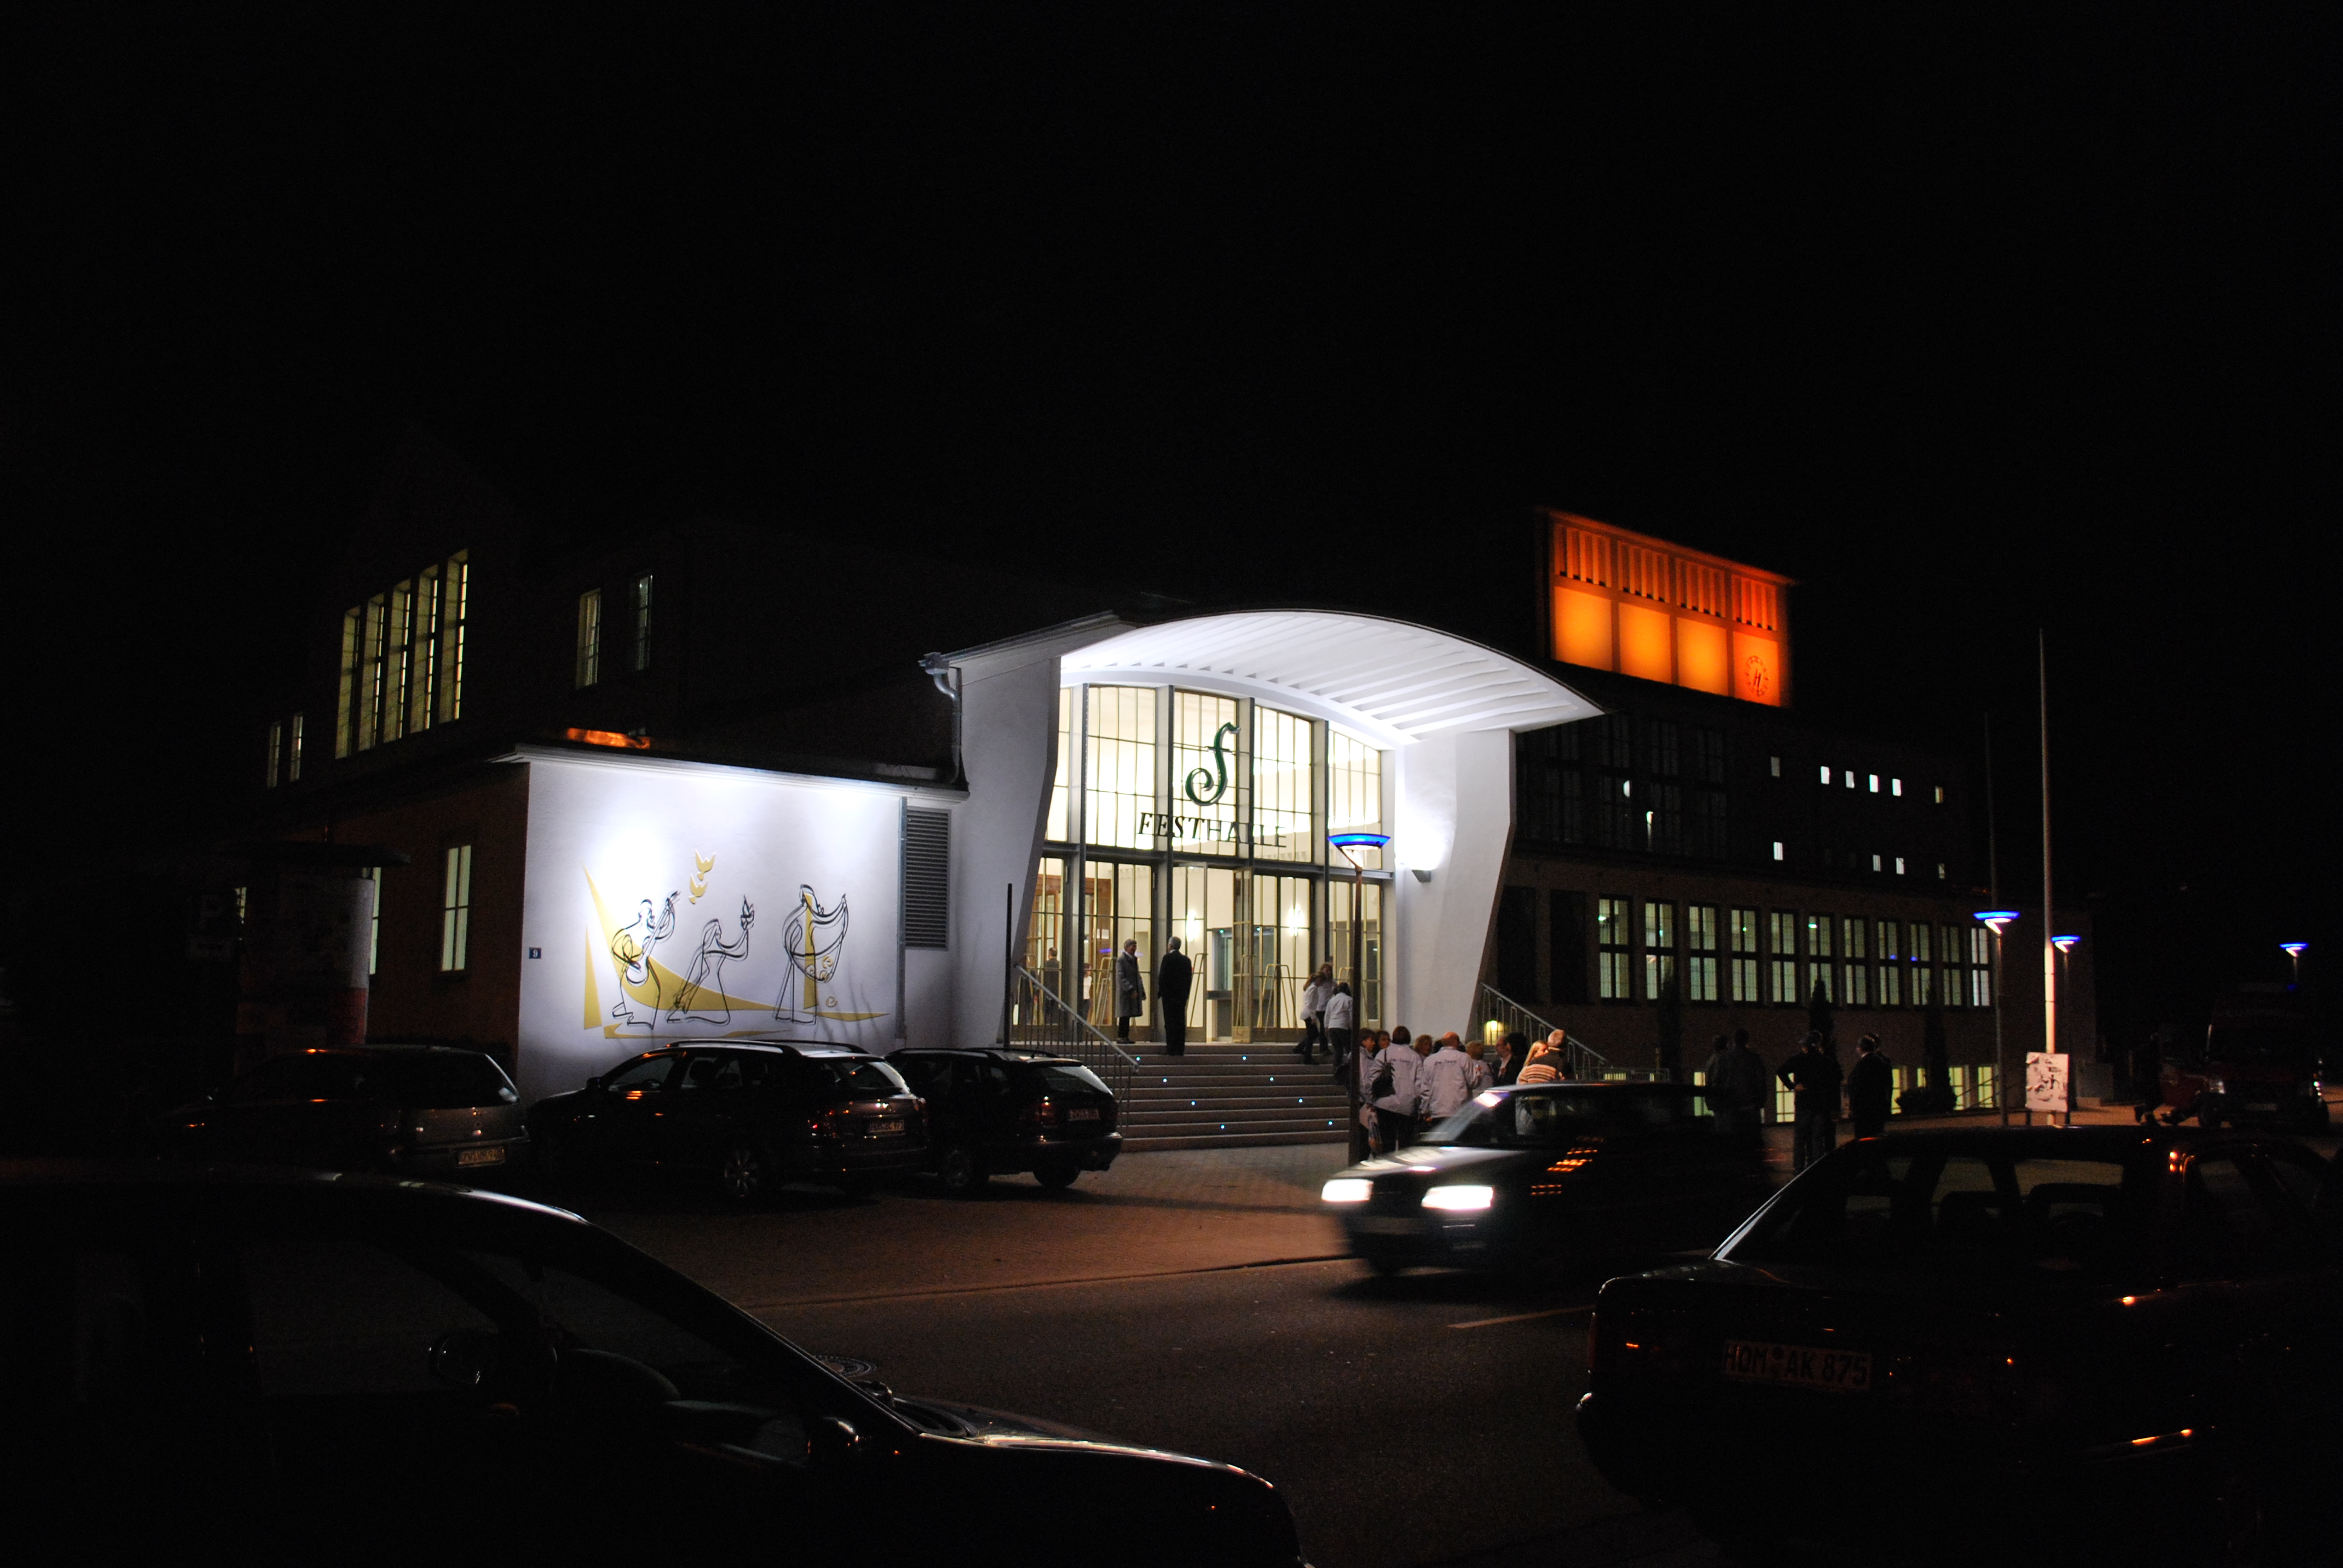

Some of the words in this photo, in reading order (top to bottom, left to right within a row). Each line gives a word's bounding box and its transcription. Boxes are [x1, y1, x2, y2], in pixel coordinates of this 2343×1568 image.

[1138, 812, 1286, 848] FESTHALLE
[1725, 1342, 1768, 1374] HOM
[1786, 1350, 1815, 1380] AK
[1822, 1353, 1867, 1386] 875
